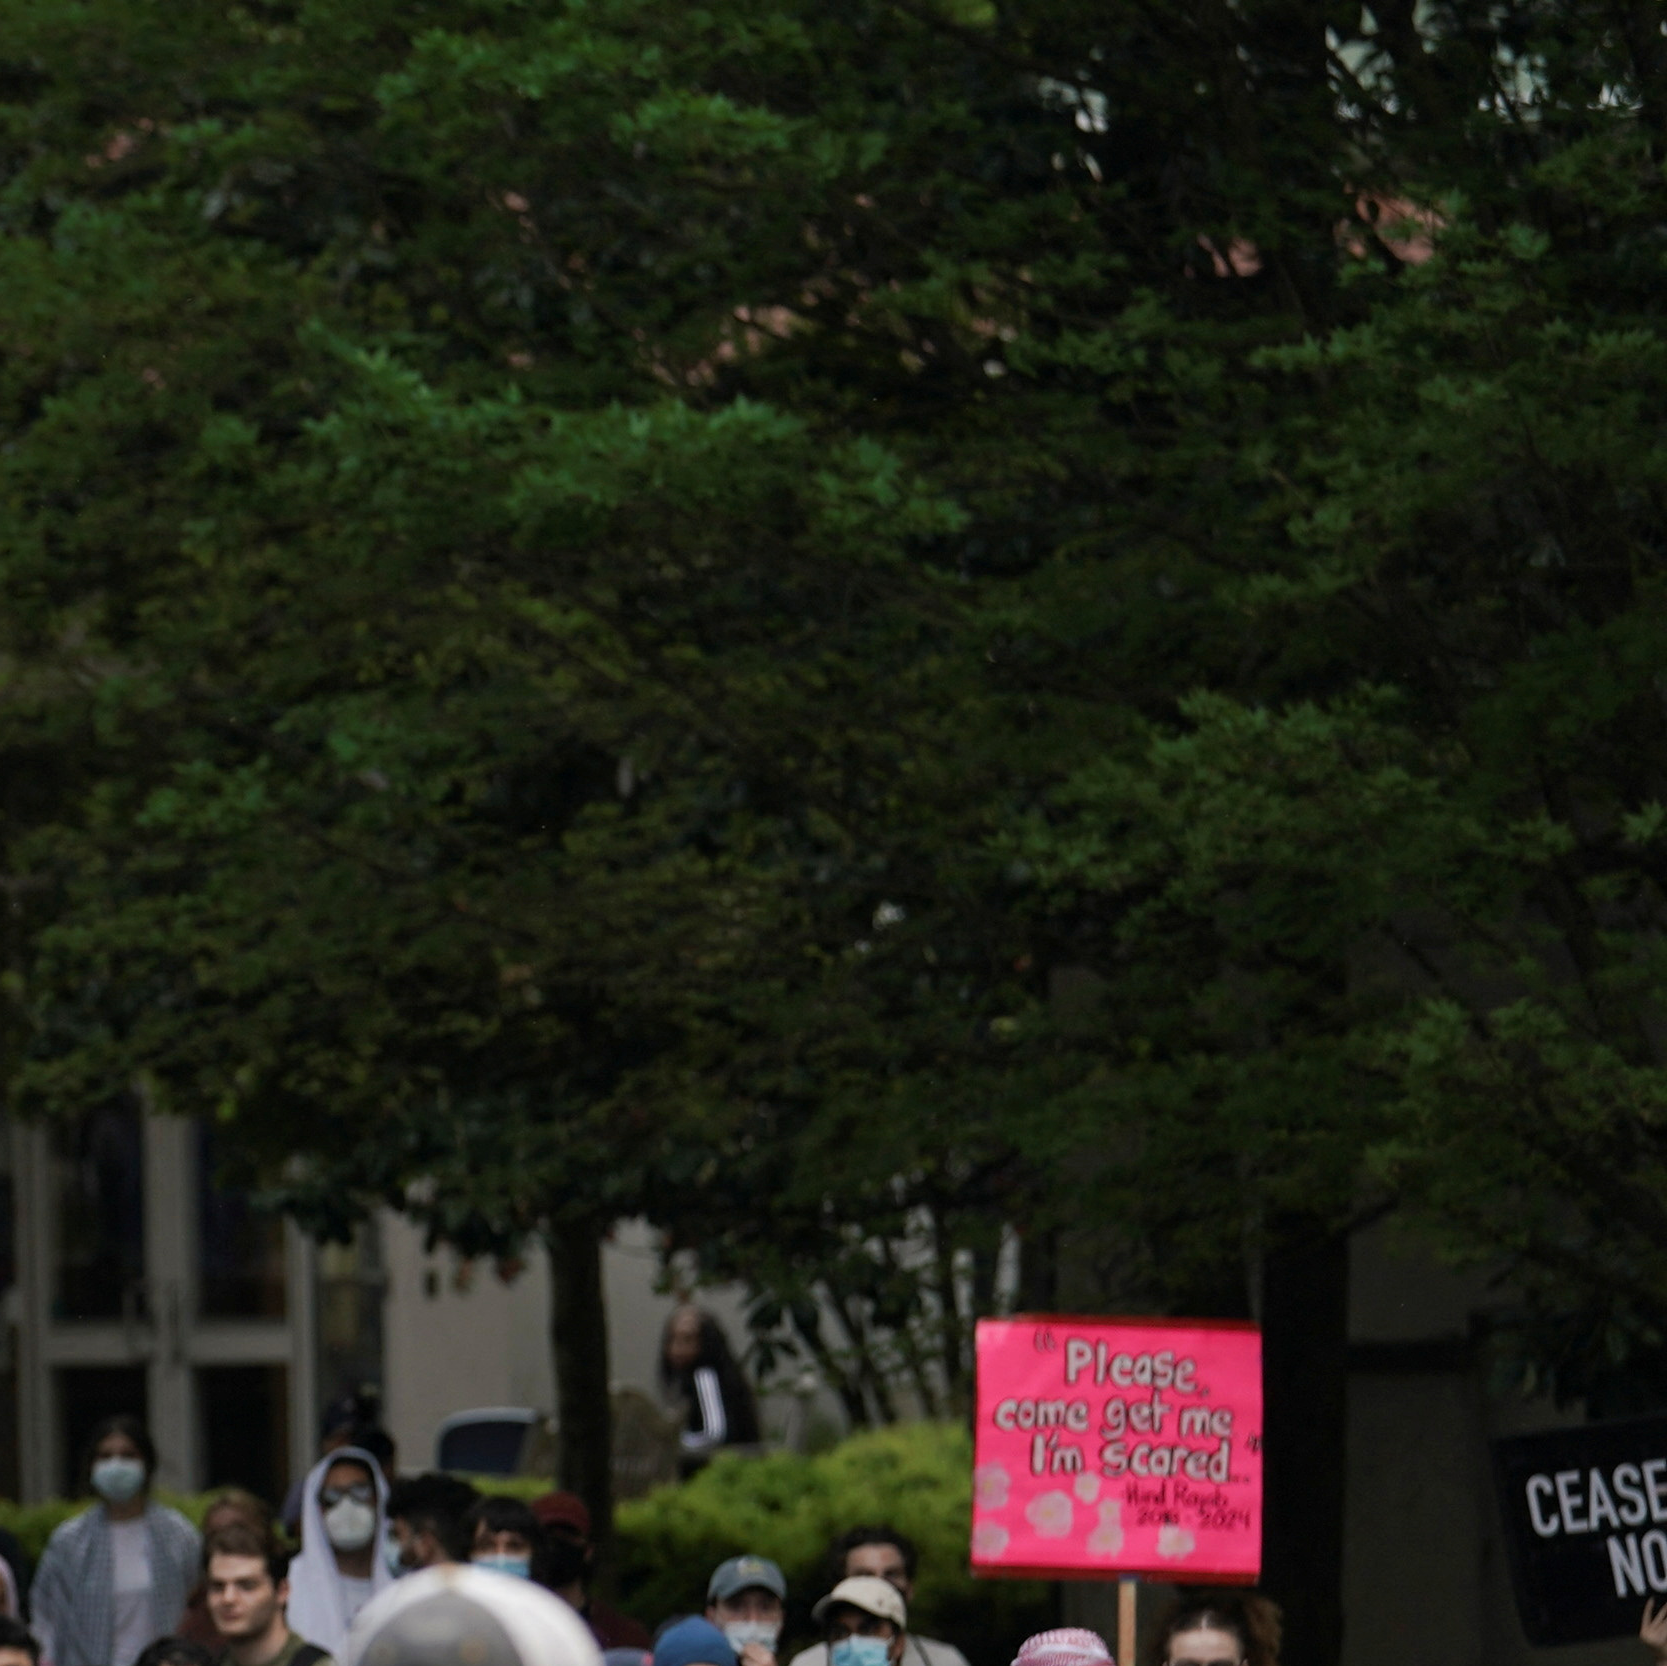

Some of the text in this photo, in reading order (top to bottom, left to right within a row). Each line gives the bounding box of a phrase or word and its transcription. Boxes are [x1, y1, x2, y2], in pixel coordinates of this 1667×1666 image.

[994, 1389, 1234, 1441] come get me
